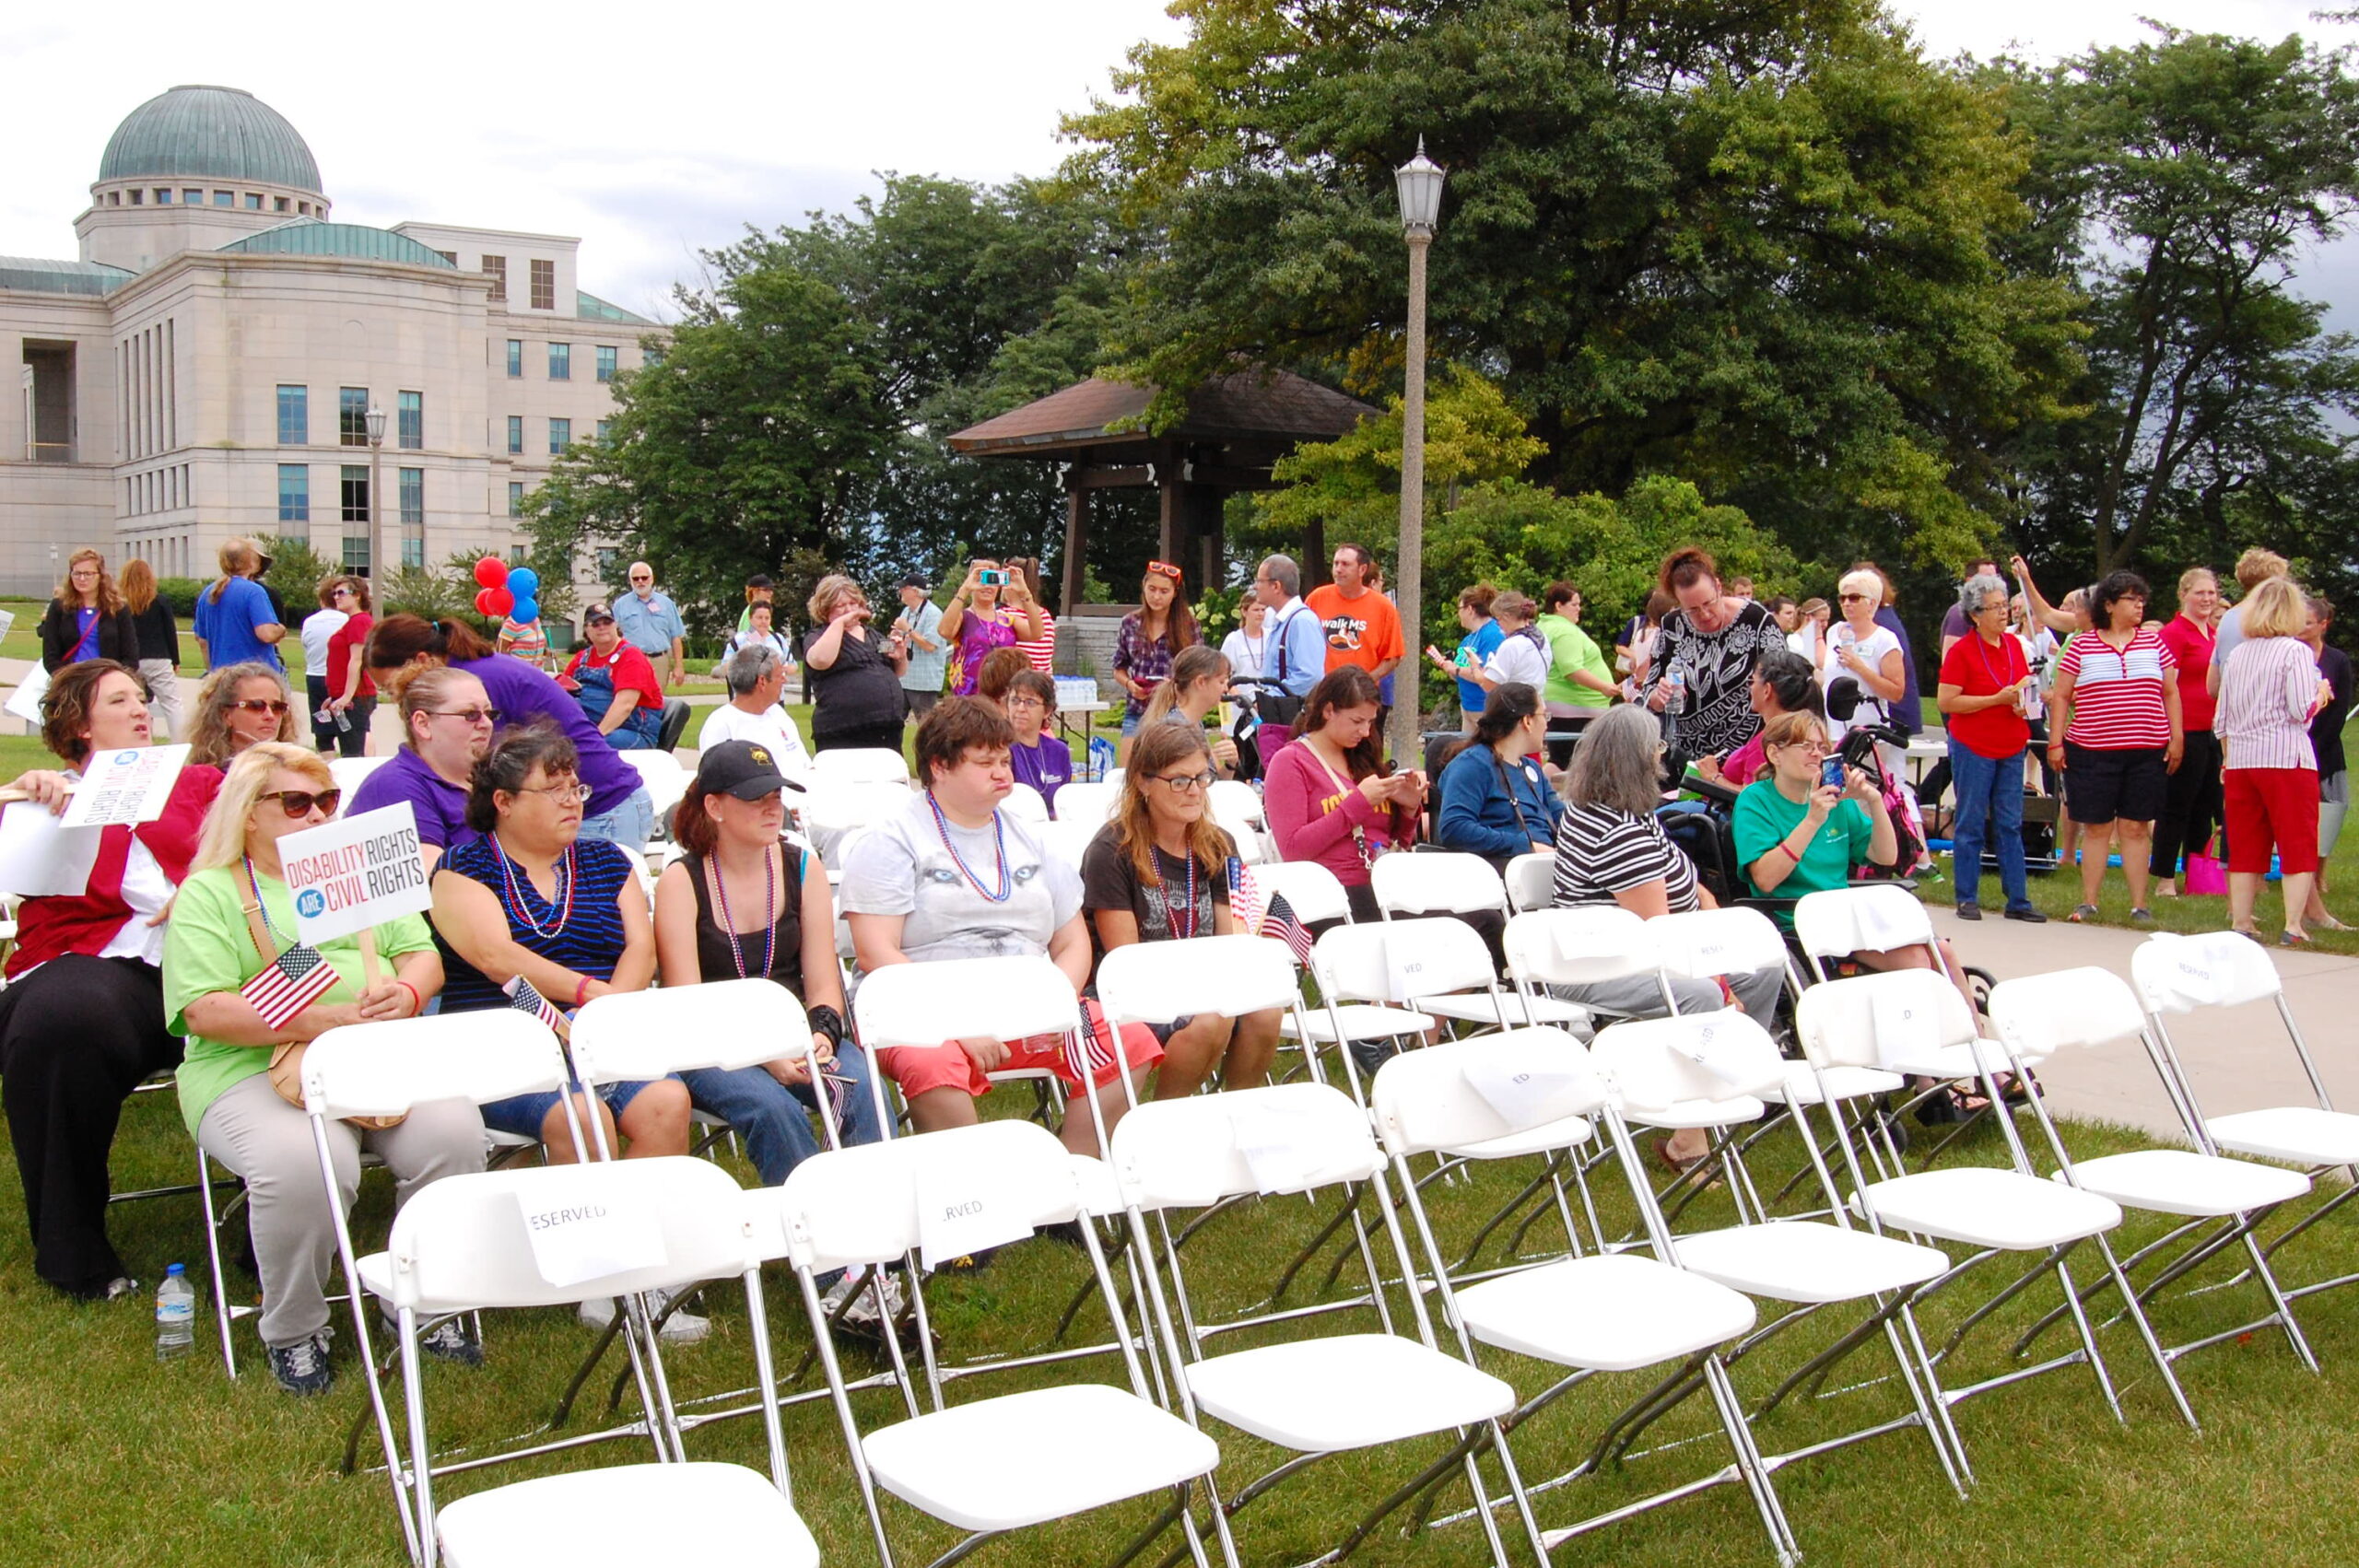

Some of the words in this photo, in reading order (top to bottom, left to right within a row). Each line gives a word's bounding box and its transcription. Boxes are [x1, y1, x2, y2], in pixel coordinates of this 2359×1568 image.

[1321, 618, 1348, 629] walk
[1348, 619, 1367, 631] MS
[84, 790, 122, 824] RIGHTS
[288, 842, 367, 889] DISABILITY
[365, 827, 417, 866] RIGHTS
[300, 892, 323, 917] ARE
[324, 874, 369, 912] CIVIL
[368, 857, 425, 899] RIGHTS
